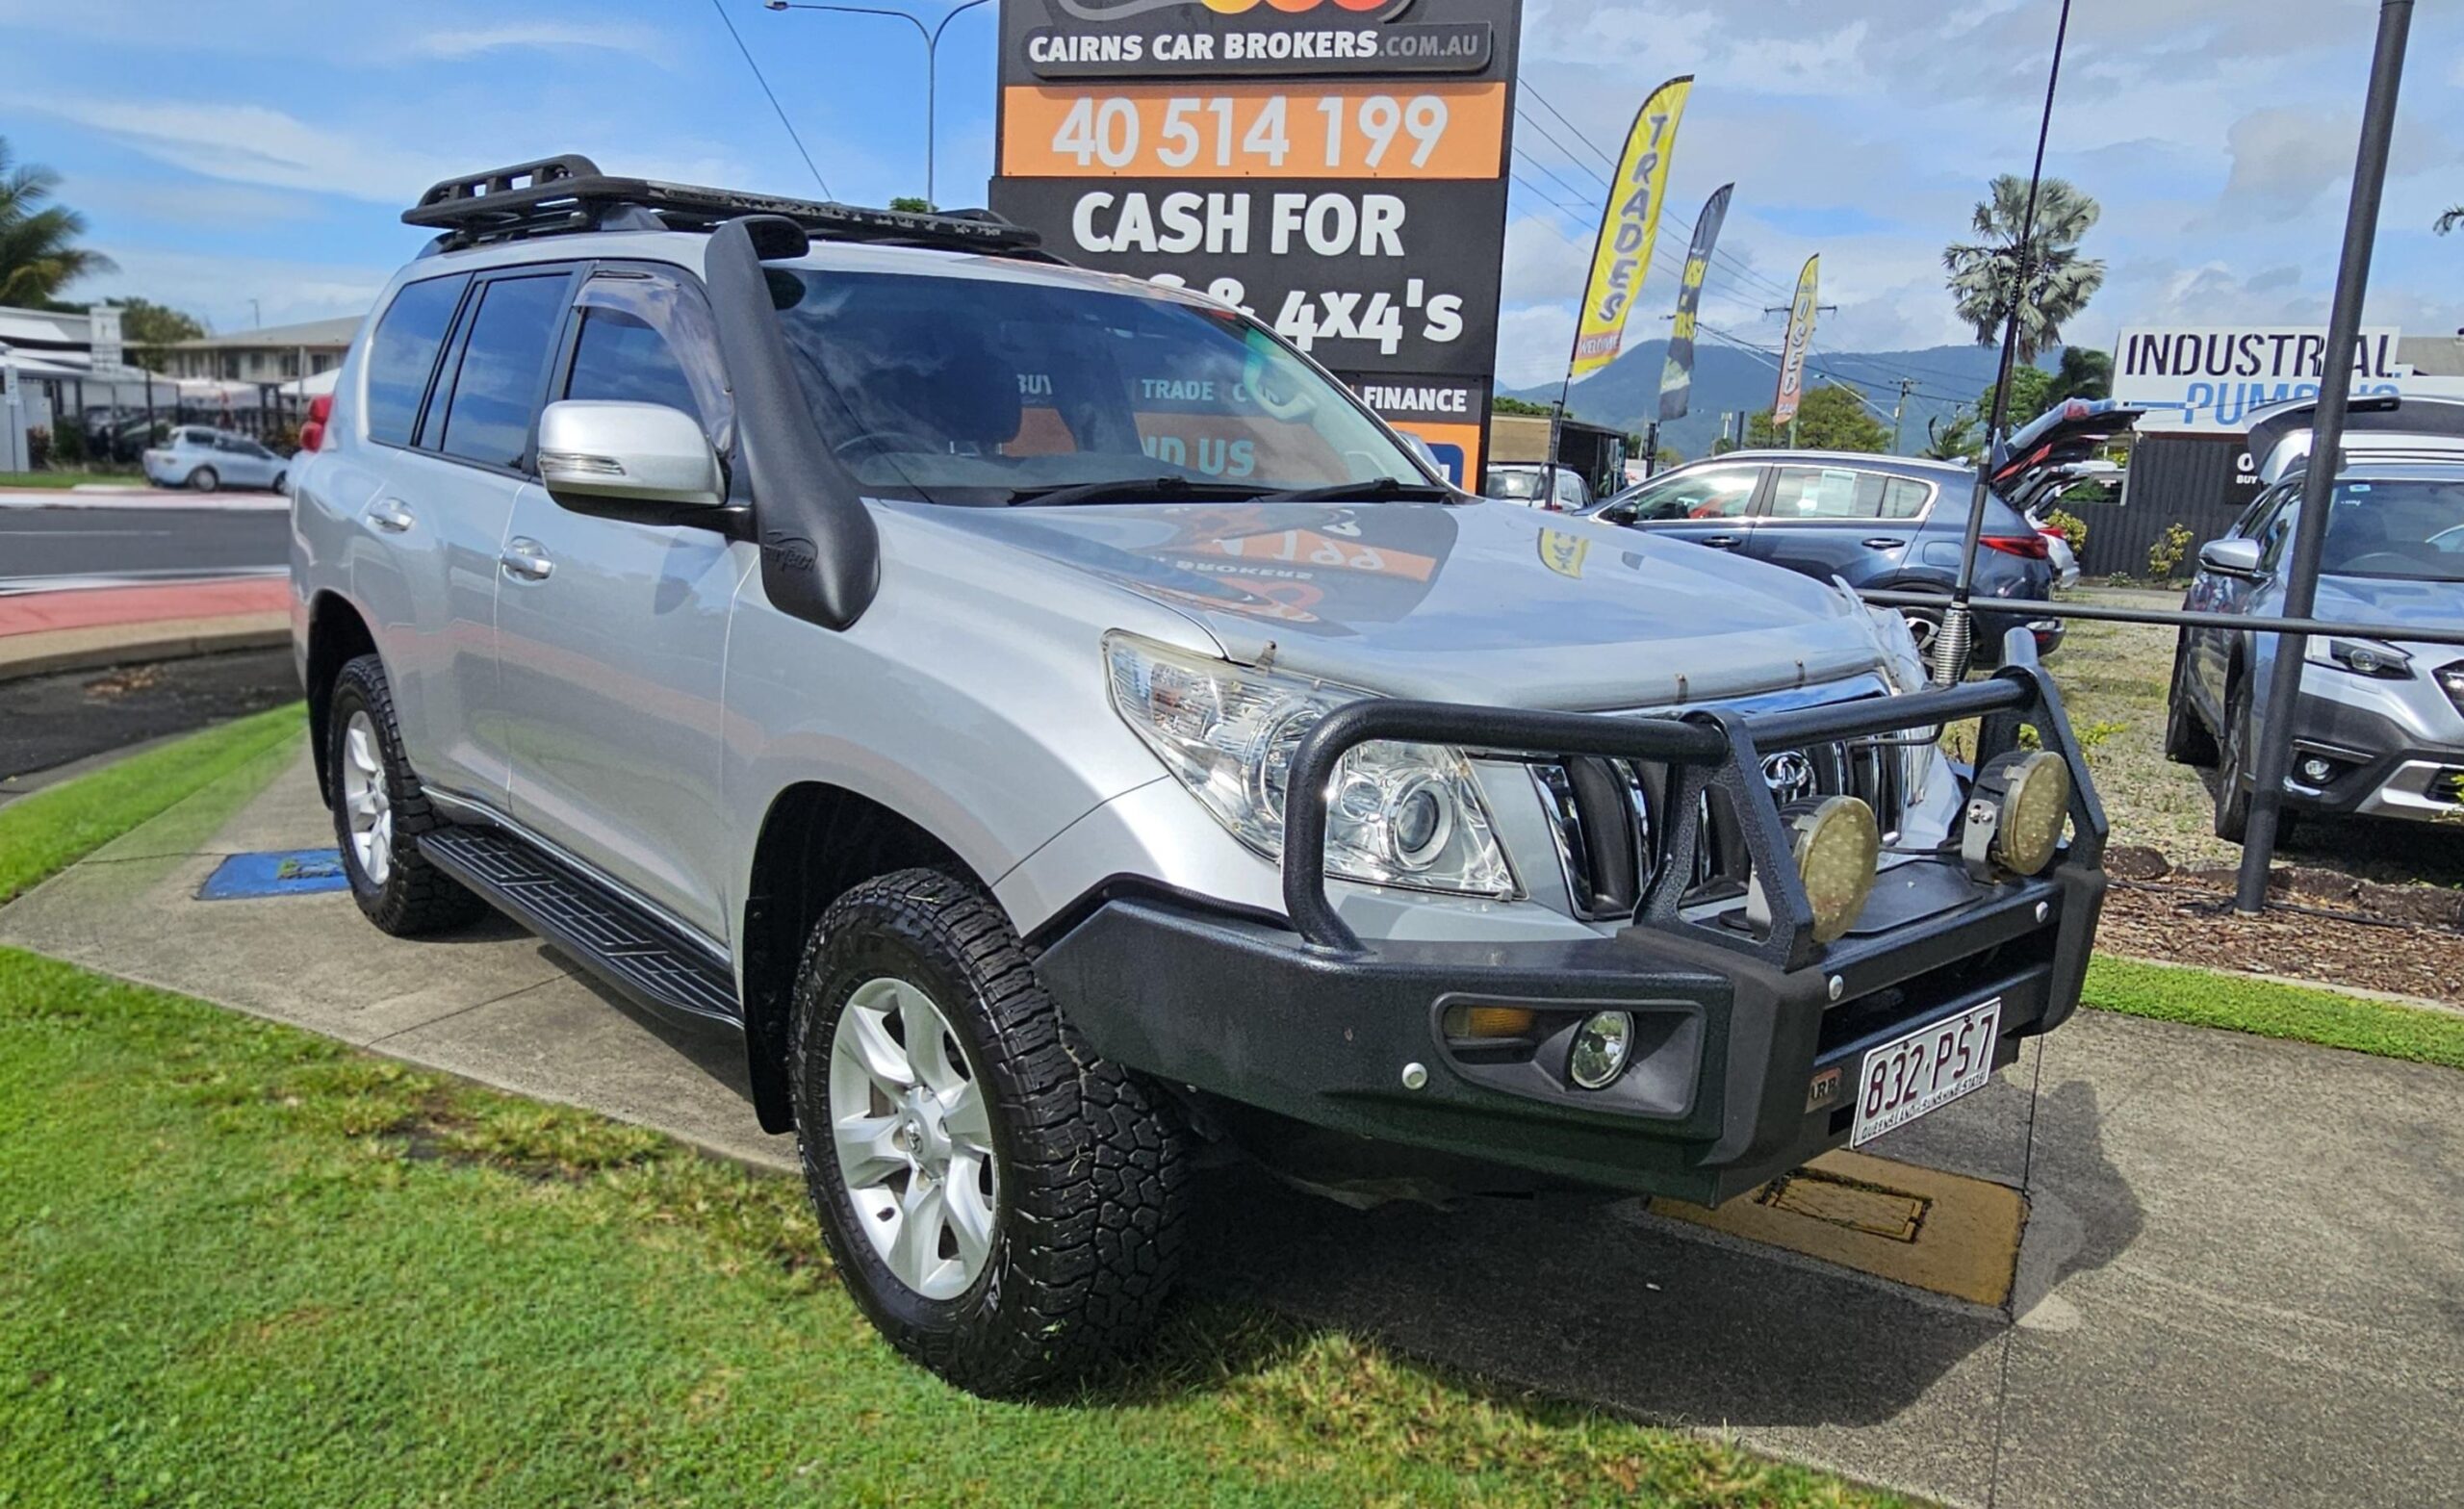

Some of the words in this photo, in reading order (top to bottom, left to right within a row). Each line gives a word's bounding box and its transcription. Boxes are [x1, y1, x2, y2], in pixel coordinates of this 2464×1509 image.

[1029, 36, 1142, 64] CAIRNS
[1153, 33, 1214, 61] CAR
[1052, 97, 1140, 167] 40
[1157, 96, 1289, 167] 514
[1317, 94, 1449, 167] 199
[1072, 192, 1250, 254] CASH
[1270, 193, 1406, 257] FOR
[1599, 115, 1669, 322] TRADES
[2125, 333, 2393, 378] INDUSTRAL
[1142, 378, 1214, 400] TRADE
[1363, 386, 1467, 412] FINANCE
[1199, 439, 1255, 476] US
[2236, 474, 2258, 484] BUY
